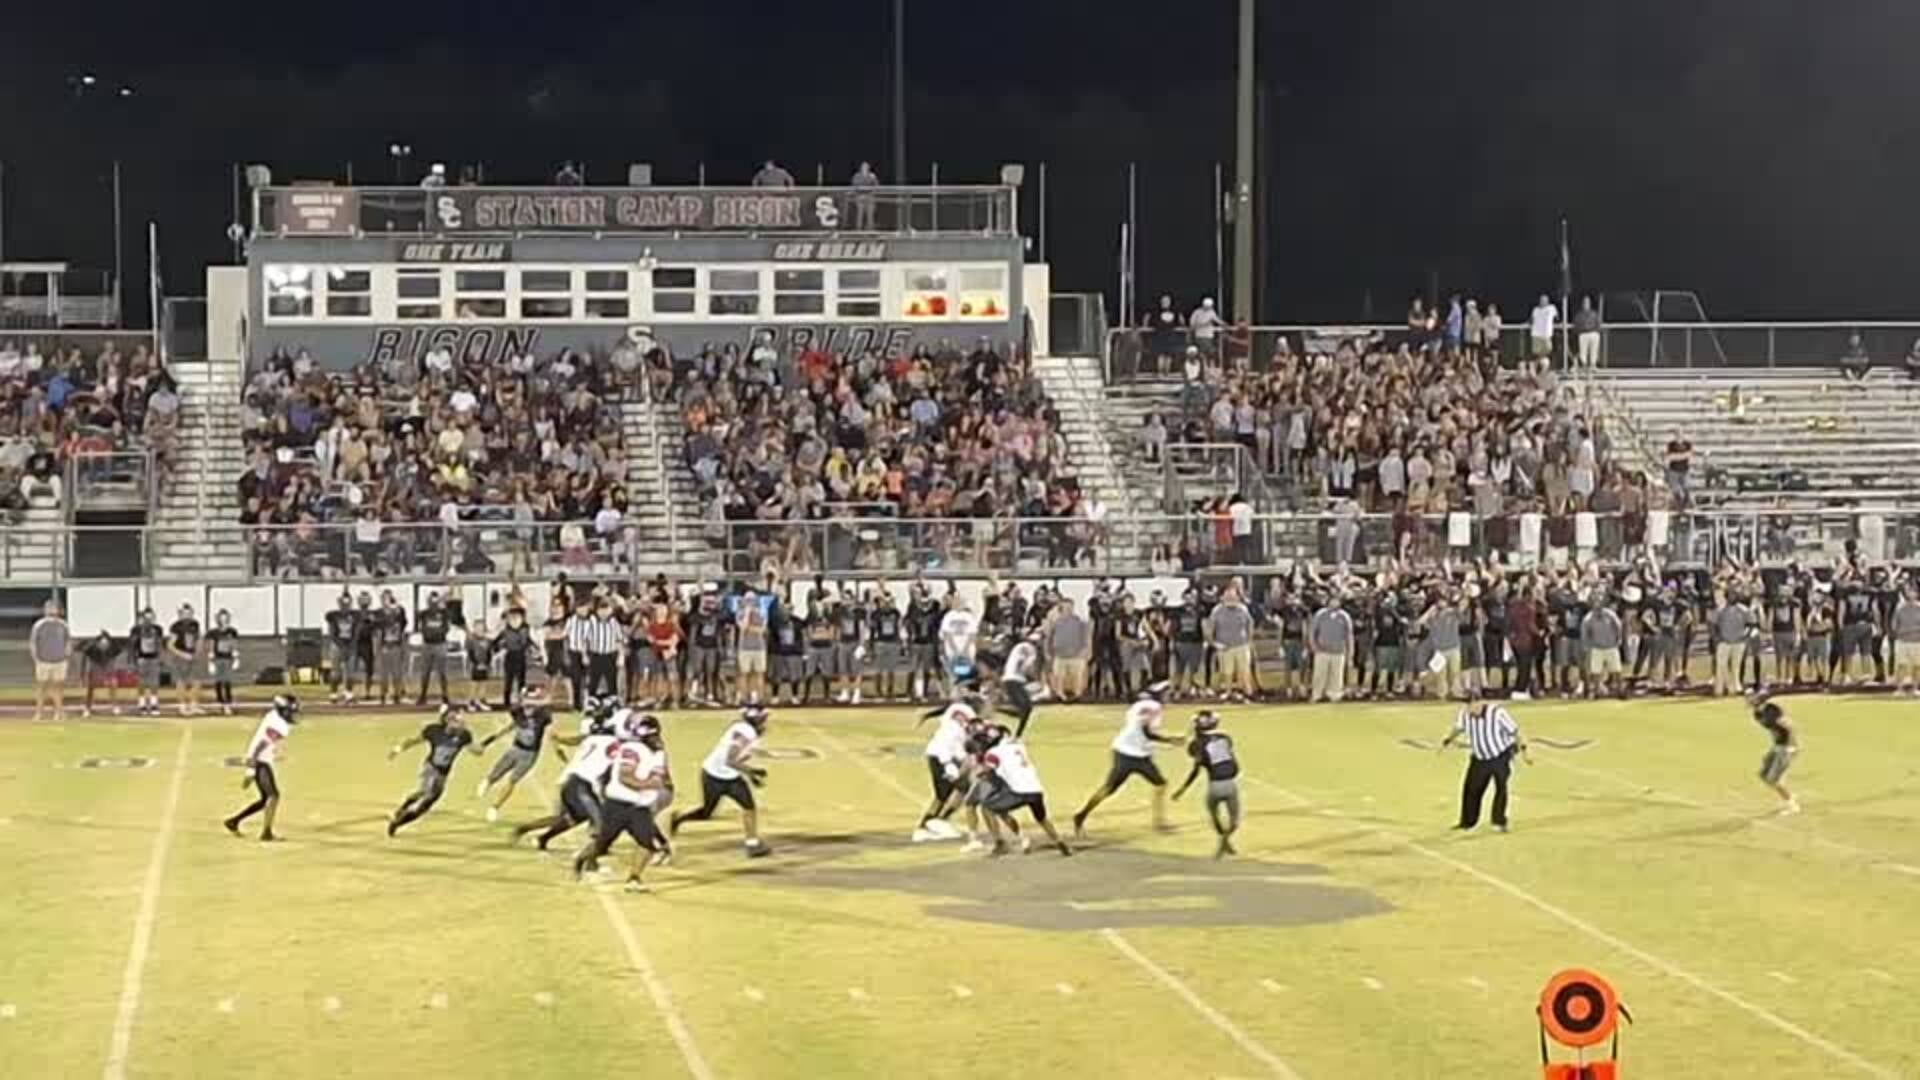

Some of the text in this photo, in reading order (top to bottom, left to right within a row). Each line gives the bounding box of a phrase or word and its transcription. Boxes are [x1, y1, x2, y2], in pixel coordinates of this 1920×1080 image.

[476, 195, 605, 226] STATION
[617, 195, 702, 226] CAMP
[713, 196, 801, 226] BISON
[450, 243, 504, 260] TEAM
